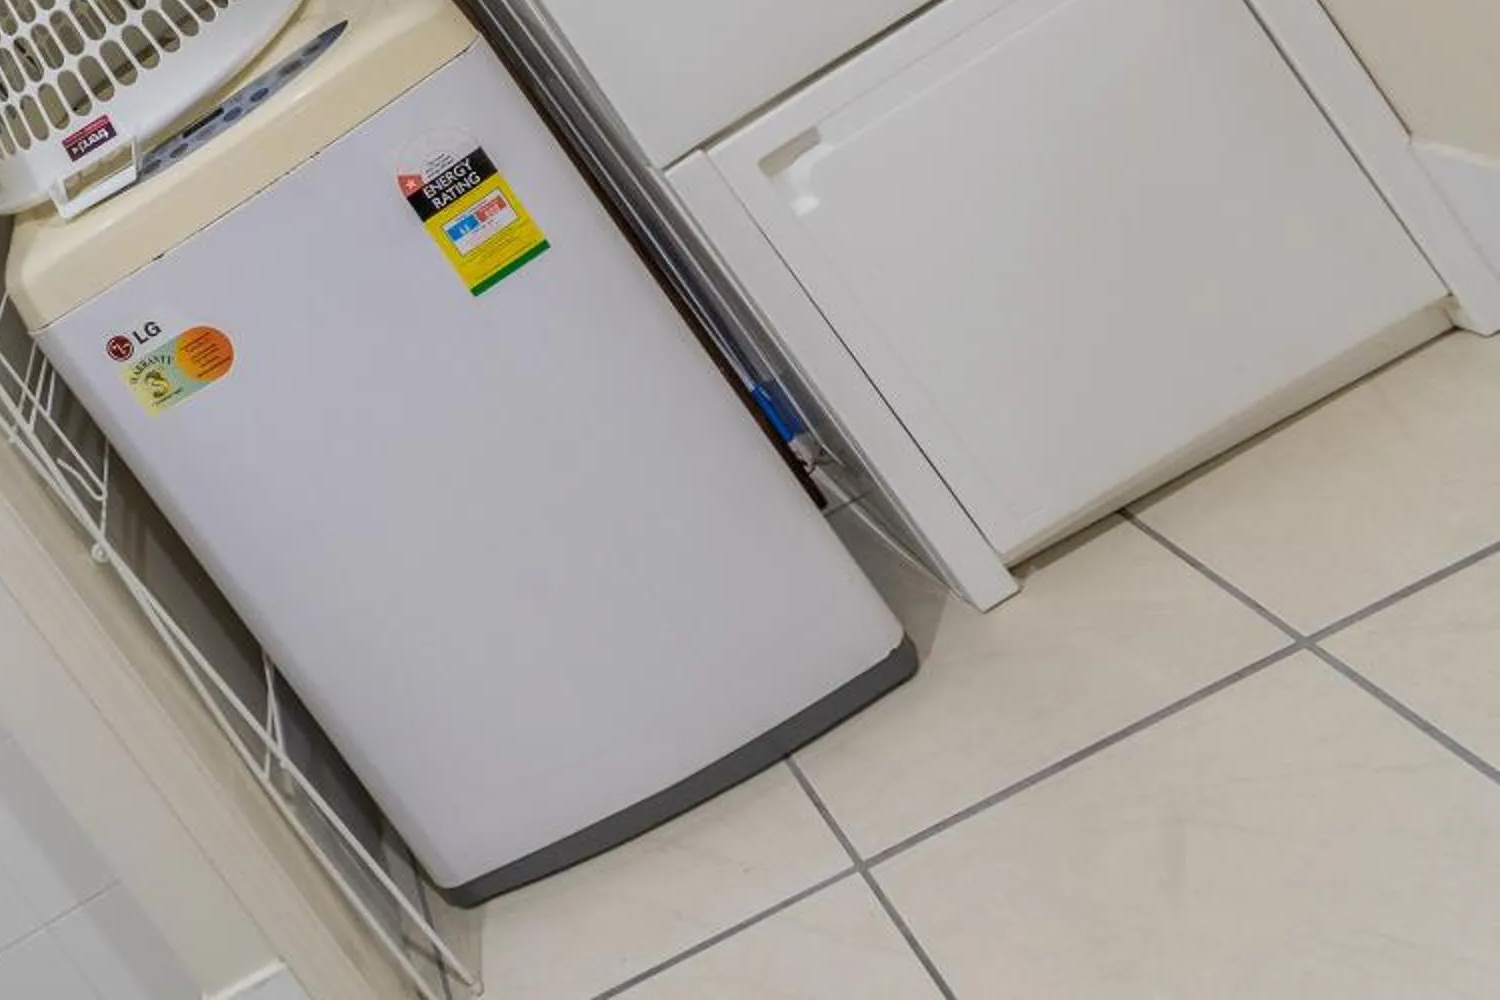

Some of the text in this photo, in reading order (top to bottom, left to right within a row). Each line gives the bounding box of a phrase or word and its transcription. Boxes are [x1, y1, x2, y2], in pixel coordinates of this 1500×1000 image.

[422, 157, 474, 199] ENERGY
[431, 171, 481, 209] RATING
[132, 321, 162, 345] LG
